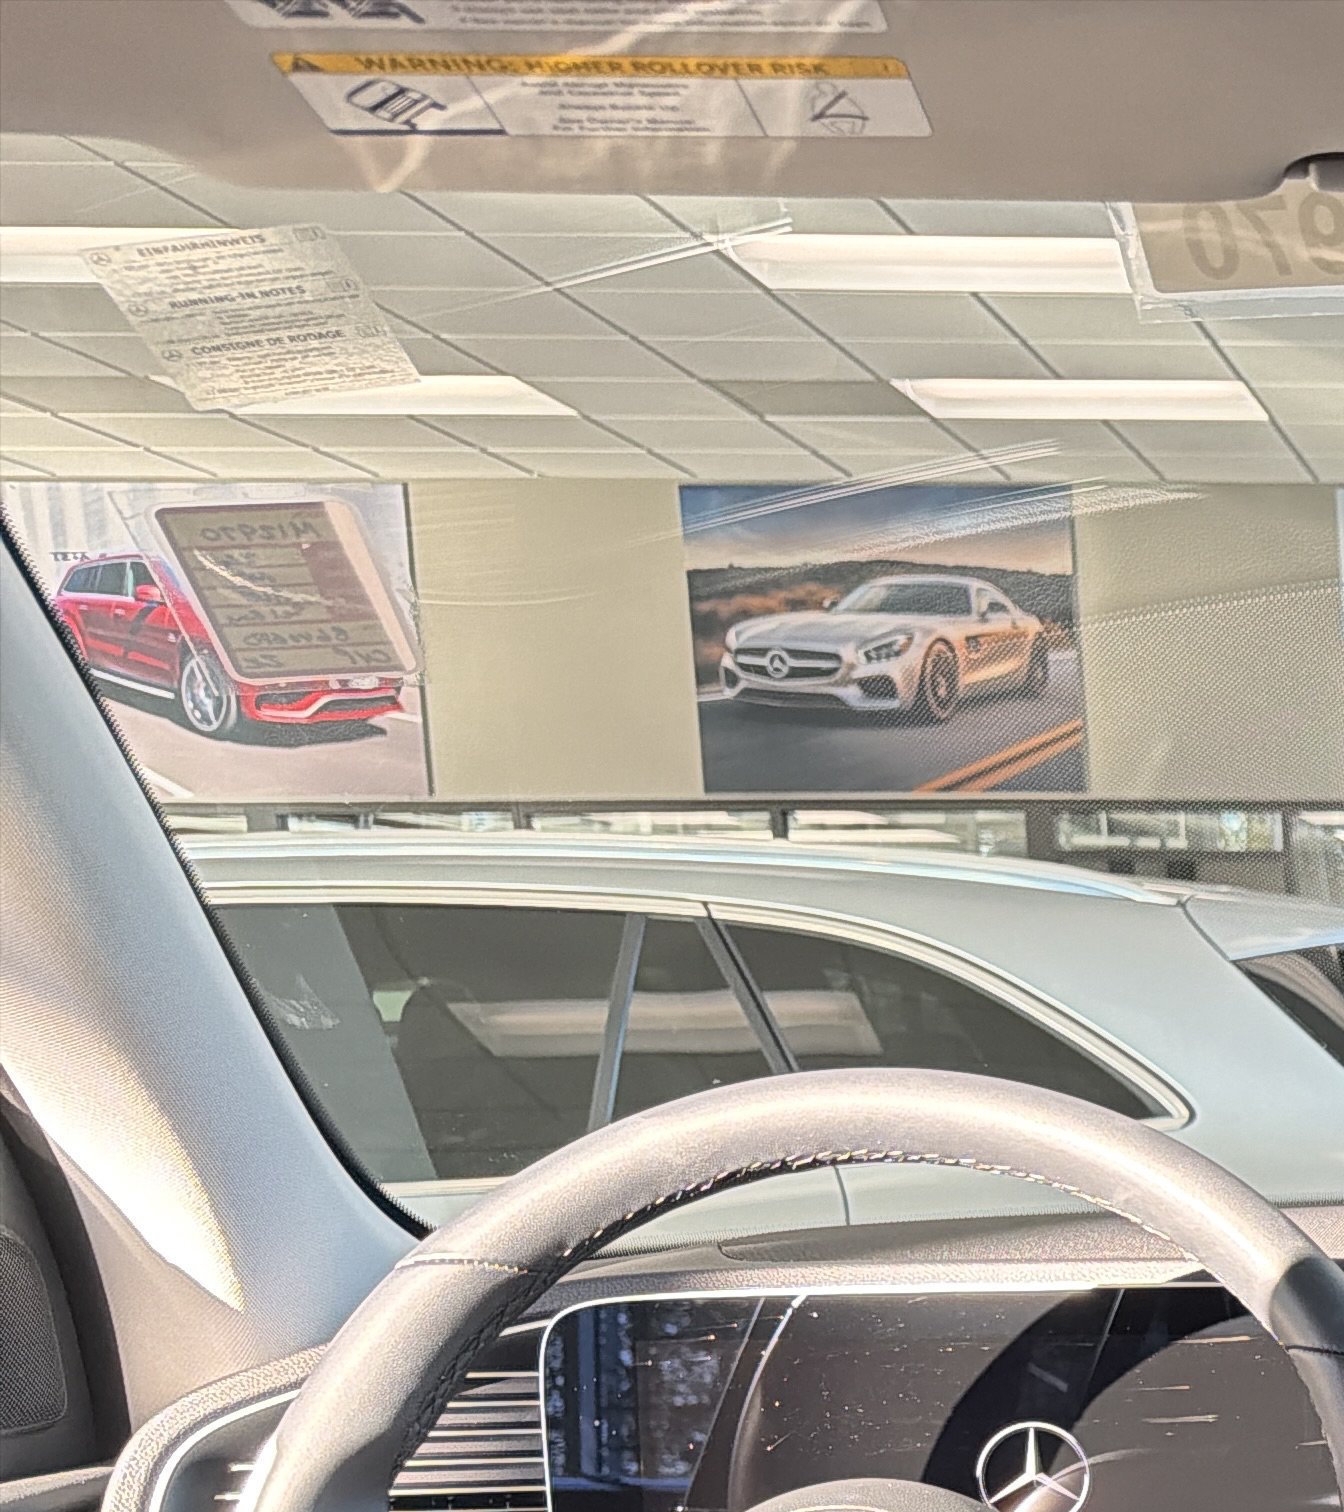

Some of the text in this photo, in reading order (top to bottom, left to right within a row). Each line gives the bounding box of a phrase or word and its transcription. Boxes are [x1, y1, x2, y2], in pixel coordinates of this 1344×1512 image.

[631, 60, 763, 76] ROLLOVER
[771, 62, 828, 76] RISK
[169, 284, 307, 310] RUNNING-IN NOTES
[191, 328, 346, 357] CONSIGNE DE RODAGE
